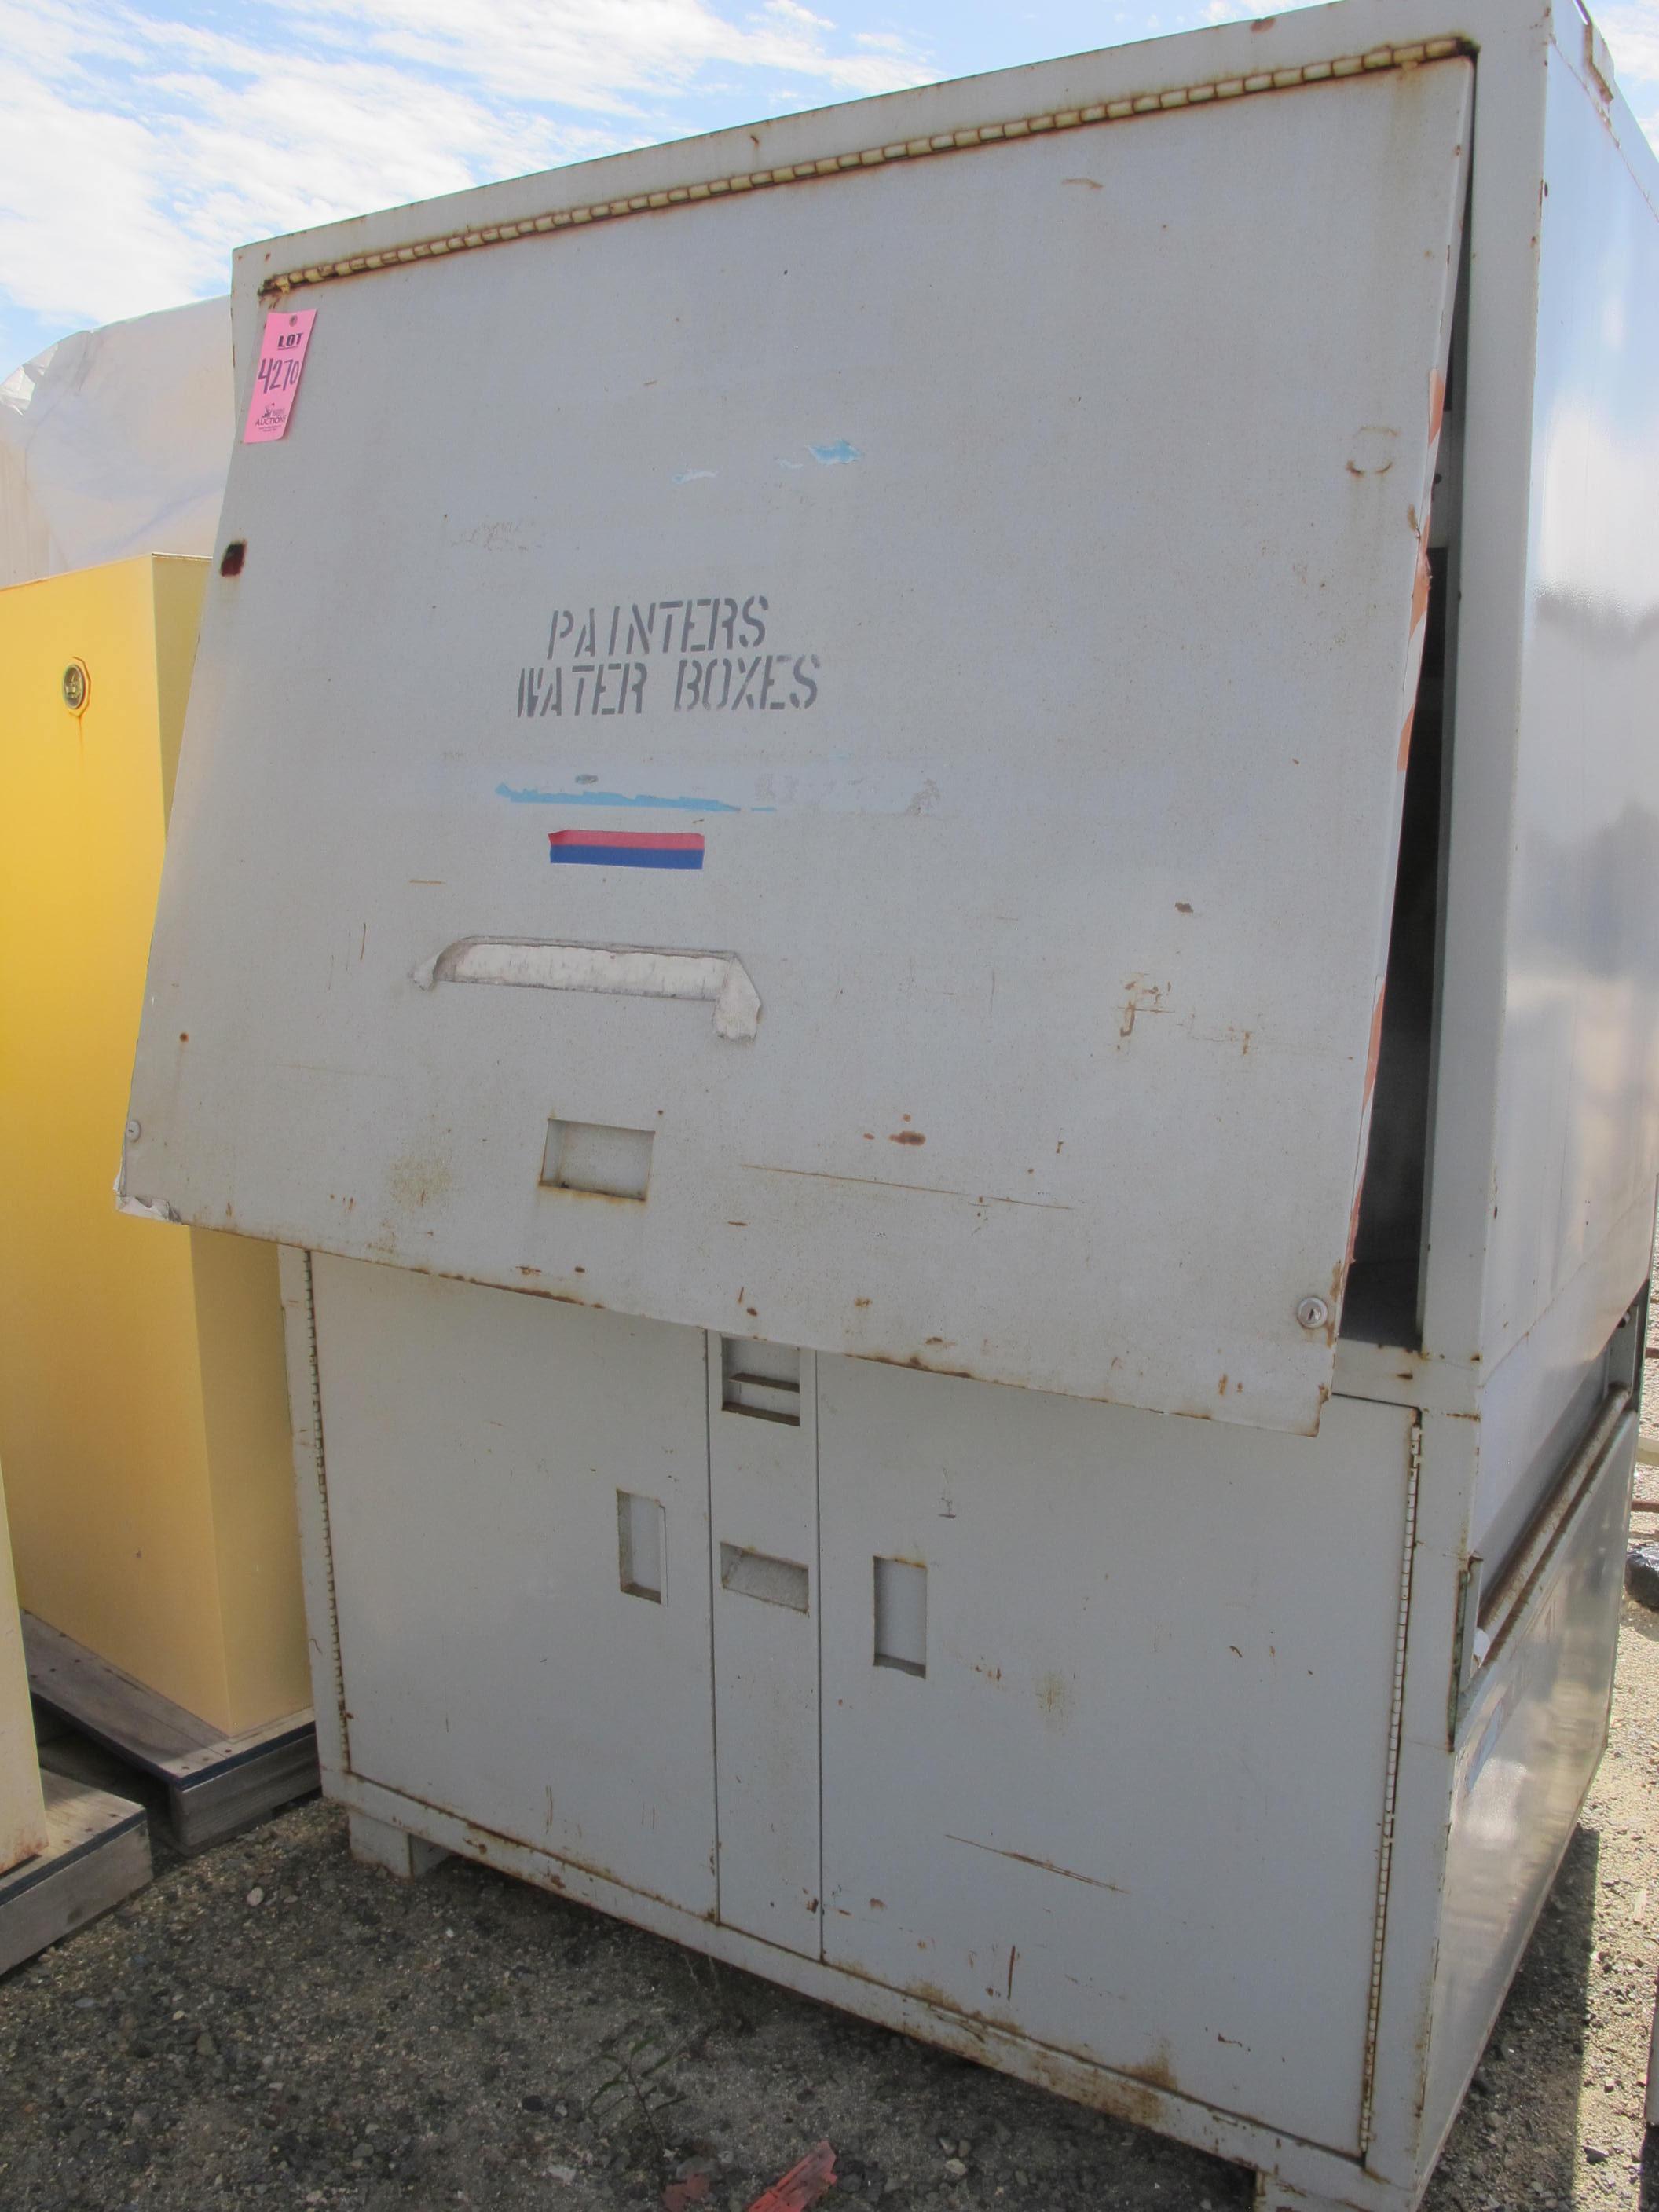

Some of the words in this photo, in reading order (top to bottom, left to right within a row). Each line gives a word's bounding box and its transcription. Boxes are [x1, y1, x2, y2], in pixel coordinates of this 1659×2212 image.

[277, 332, 303, 348] LOT
[258, 357, 300, 394] 4270
[547, 595, 769, 660] PAINTERS
[517, 662, 647, 717] WATER
[673, 654, 821, 712] BOXES
